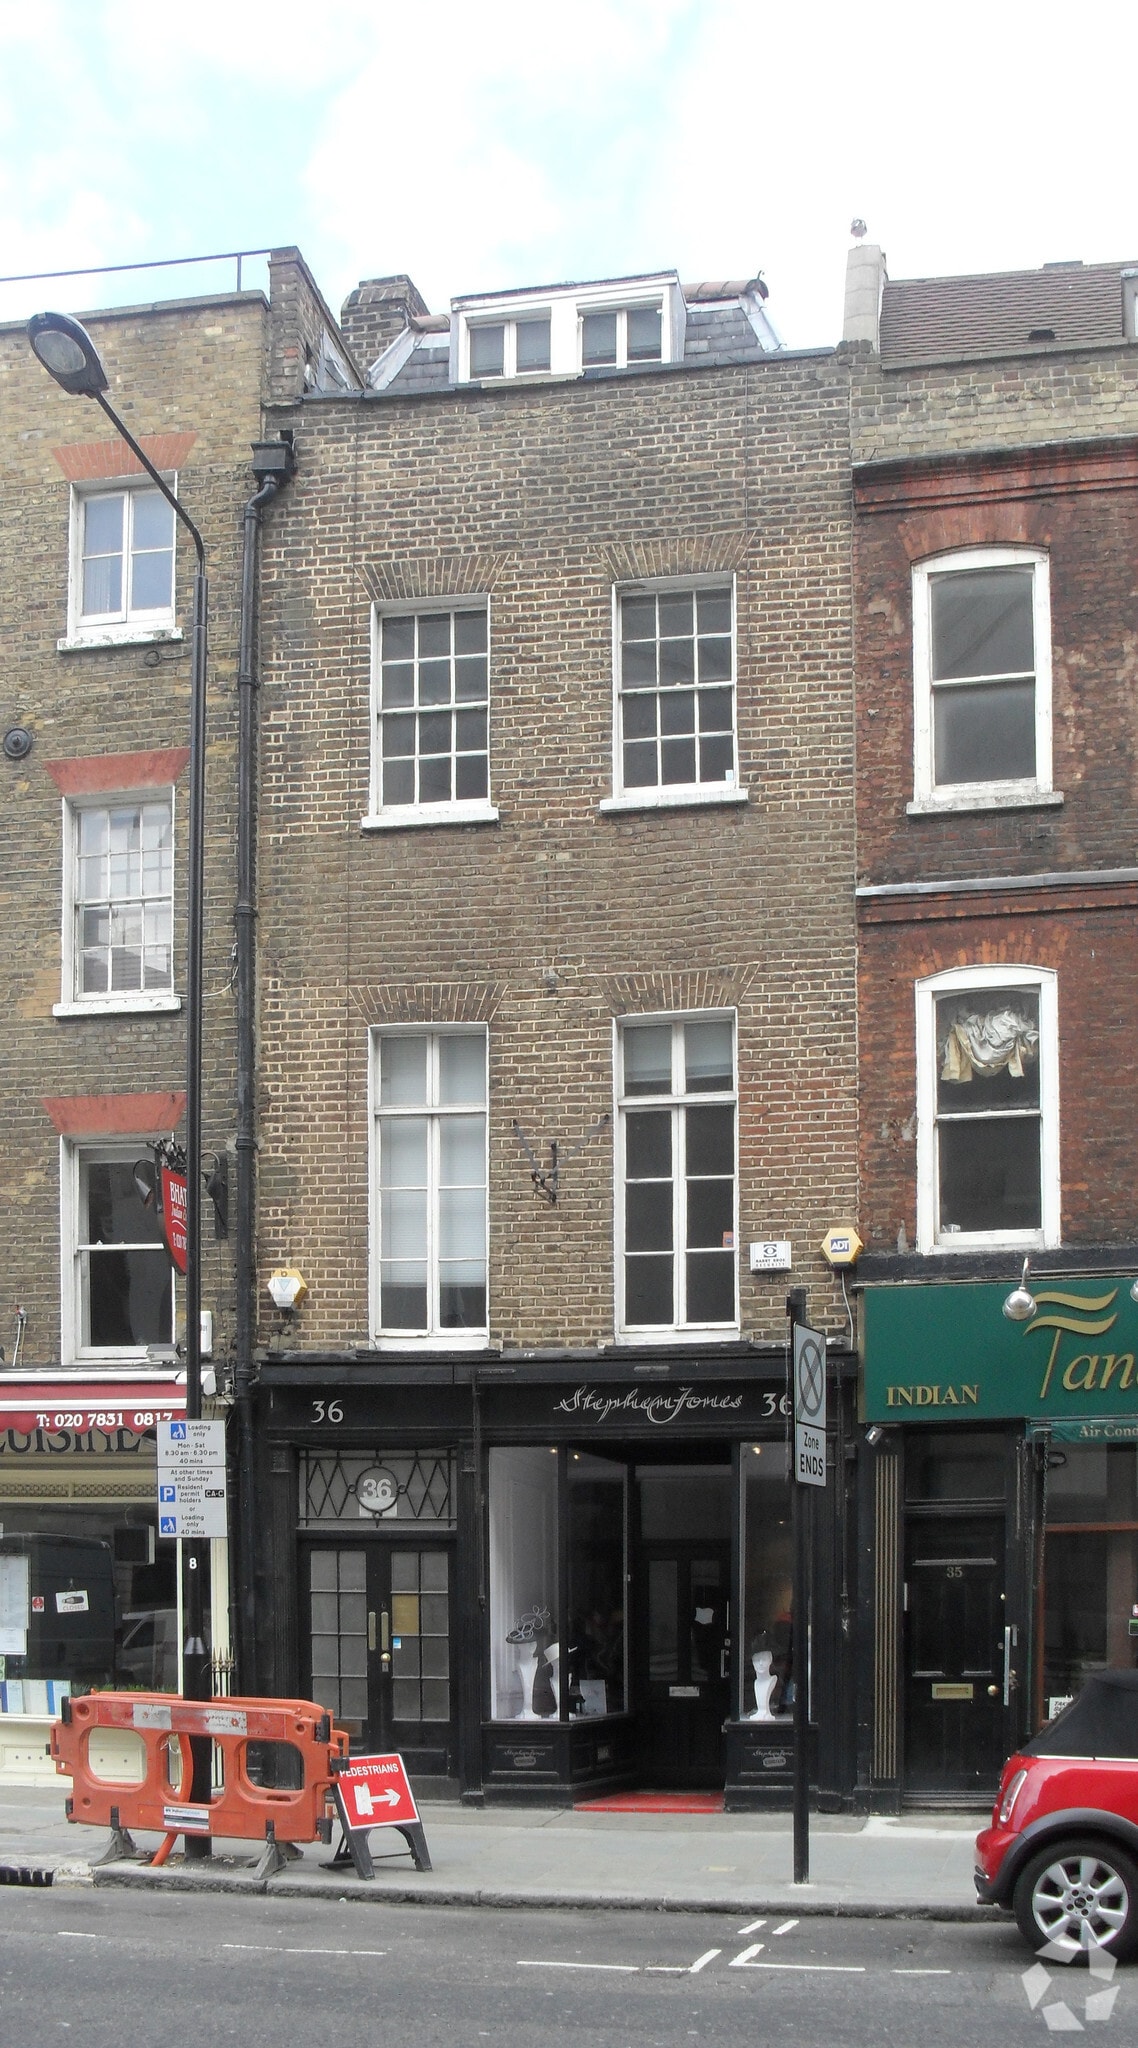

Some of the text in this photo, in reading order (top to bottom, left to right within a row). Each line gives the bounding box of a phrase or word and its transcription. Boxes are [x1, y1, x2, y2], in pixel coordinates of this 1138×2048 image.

[831, 1241, 849, 1251] ADT
[886, 1385, 979, 1406] INDIAN
[311, 1399, 344, 1423] 36
[36, 1412, 173, 1427] T: 020 7831 0817
[1080, 1425, 1100, 1437] Air
[0, 1428, 141, 1452] UISINE
[804, 1431, 819, 1450] Zone
[800, 1453, 823, 1477] ENDS
[163, 1487, 174, 1501] P
[362, 1478, 391, 1498] 36
[189, 1557, 197, 1569] 8
[946, 1566, 963, 1578] 35
[340, 1763, 399, 1778] PEDESTRIANS
